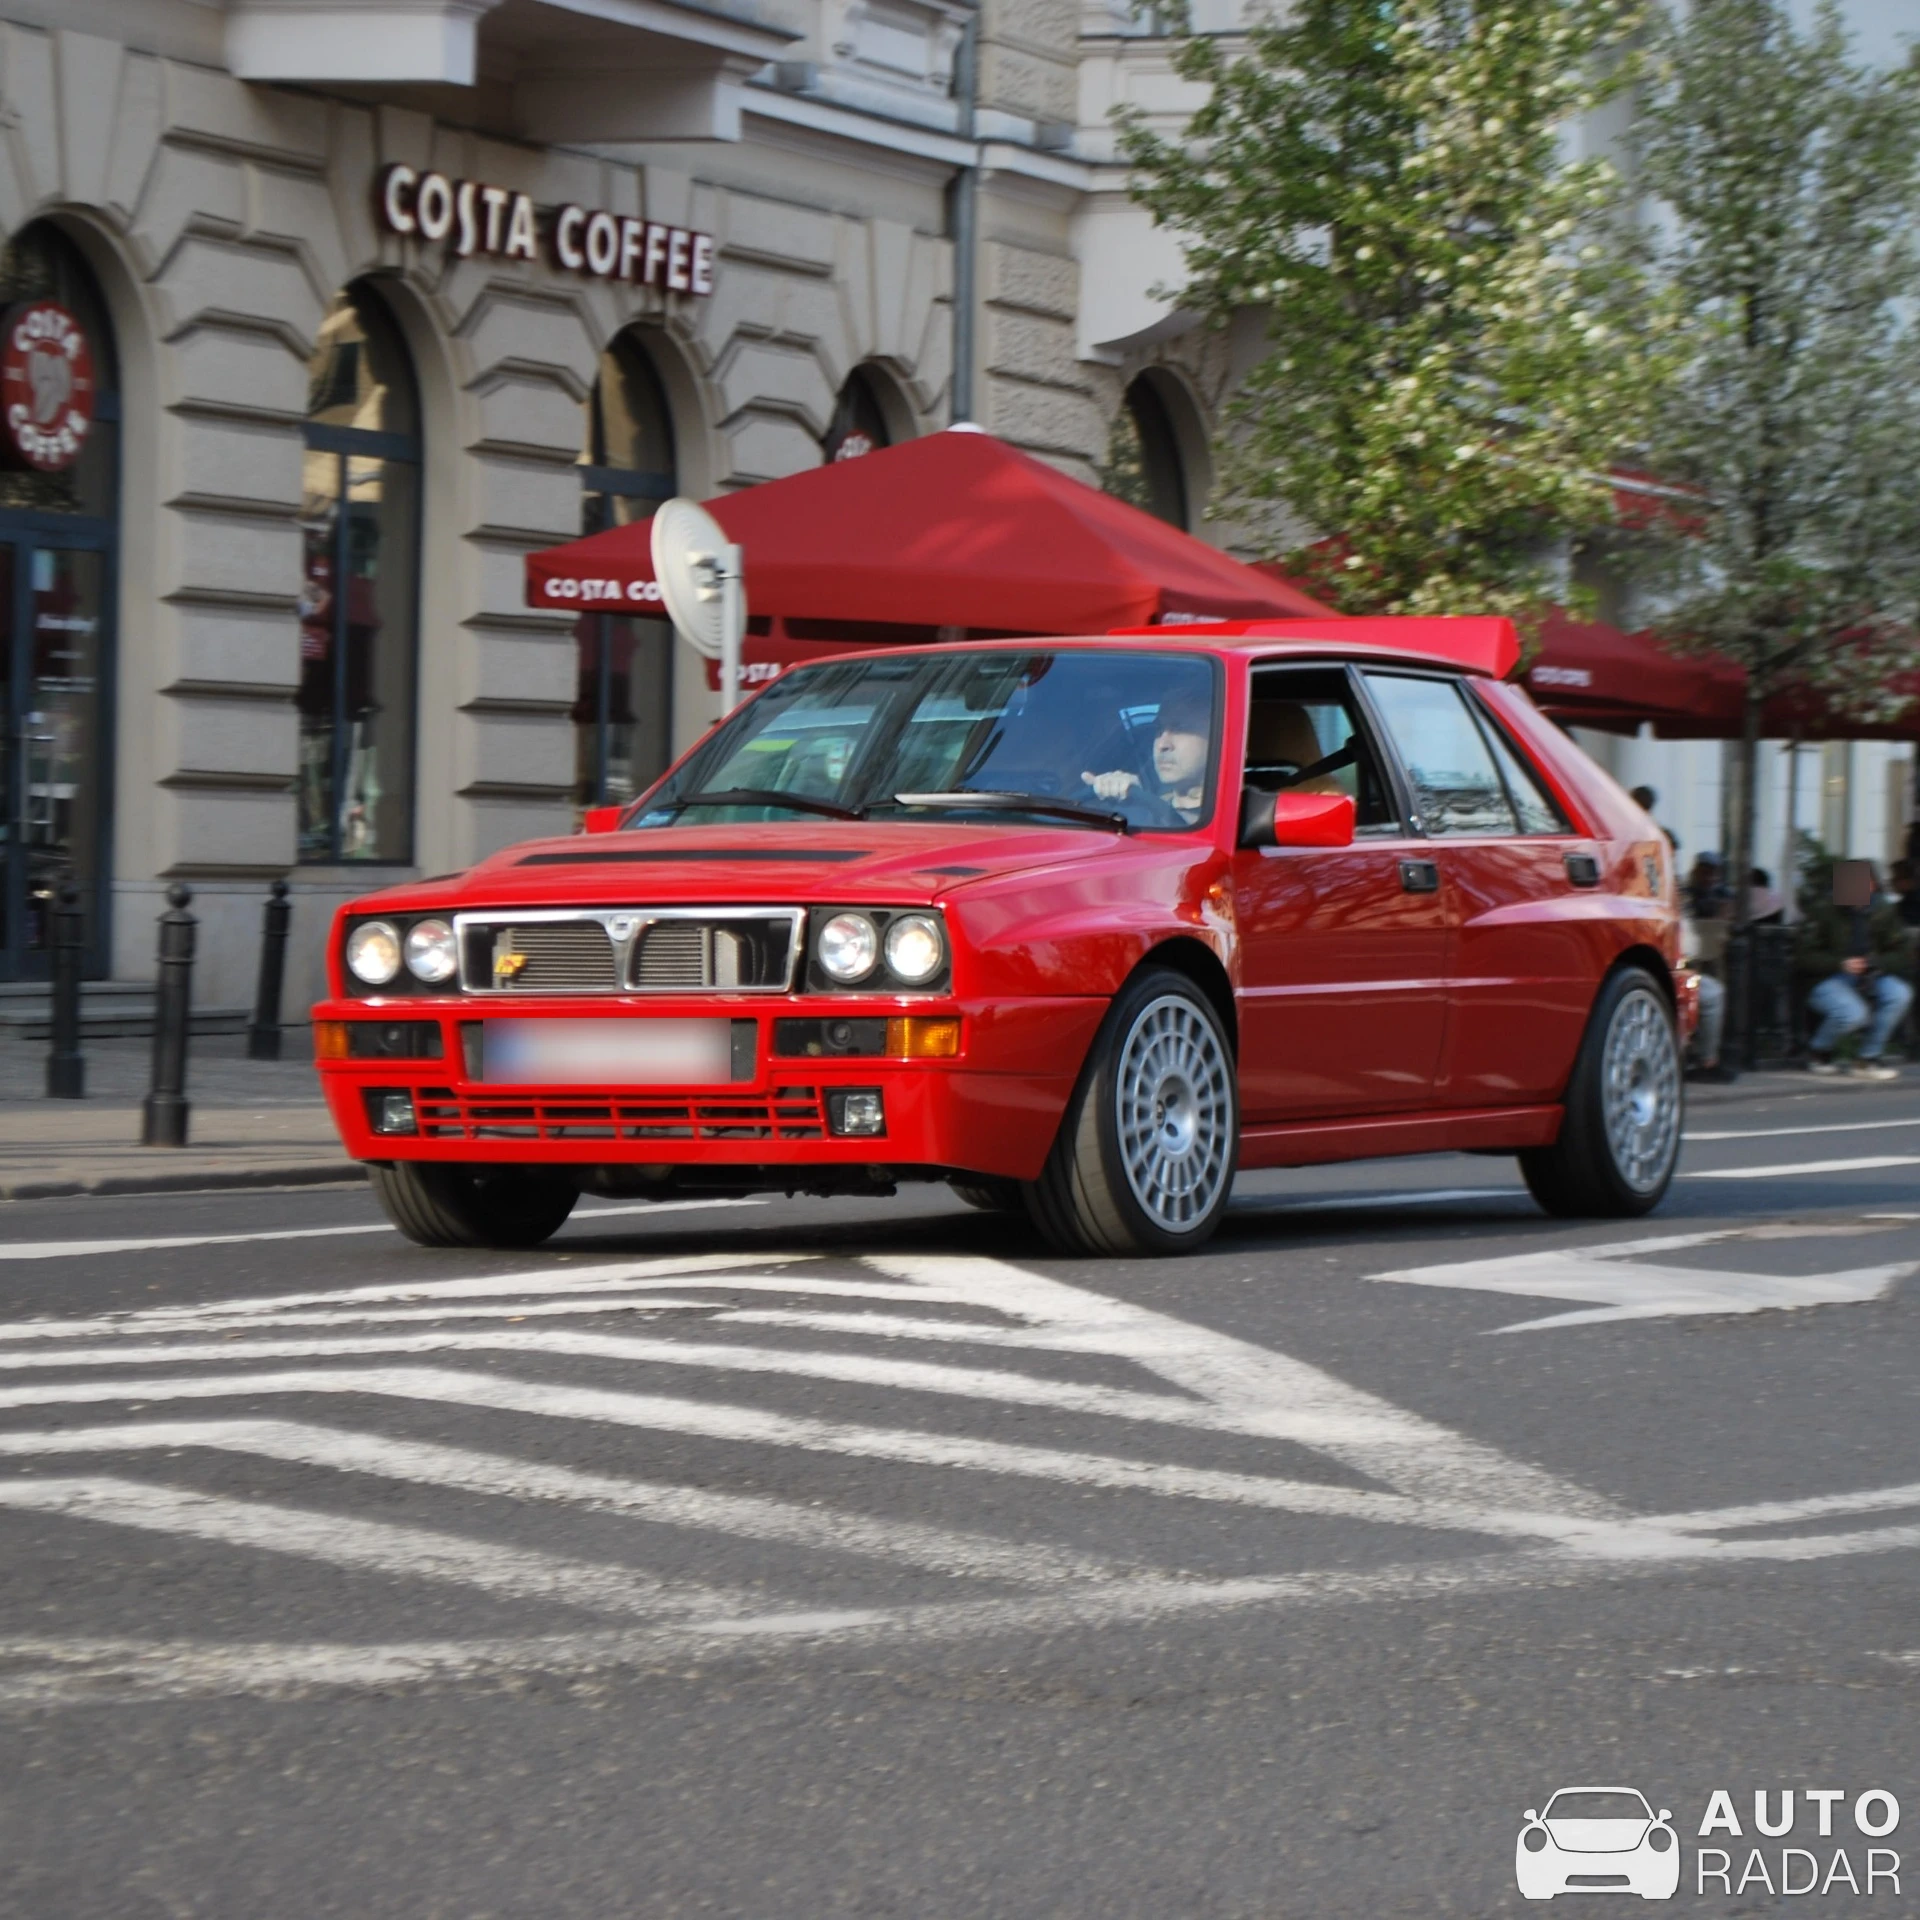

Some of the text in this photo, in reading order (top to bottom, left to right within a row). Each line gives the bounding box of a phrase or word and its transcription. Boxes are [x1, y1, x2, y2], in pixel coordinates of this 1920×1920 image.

[384, 164, 713, 294] COSTA COFFEE
[13, 308, 82, 360] COSTA
[544, 578, 622, 601] COSTA
